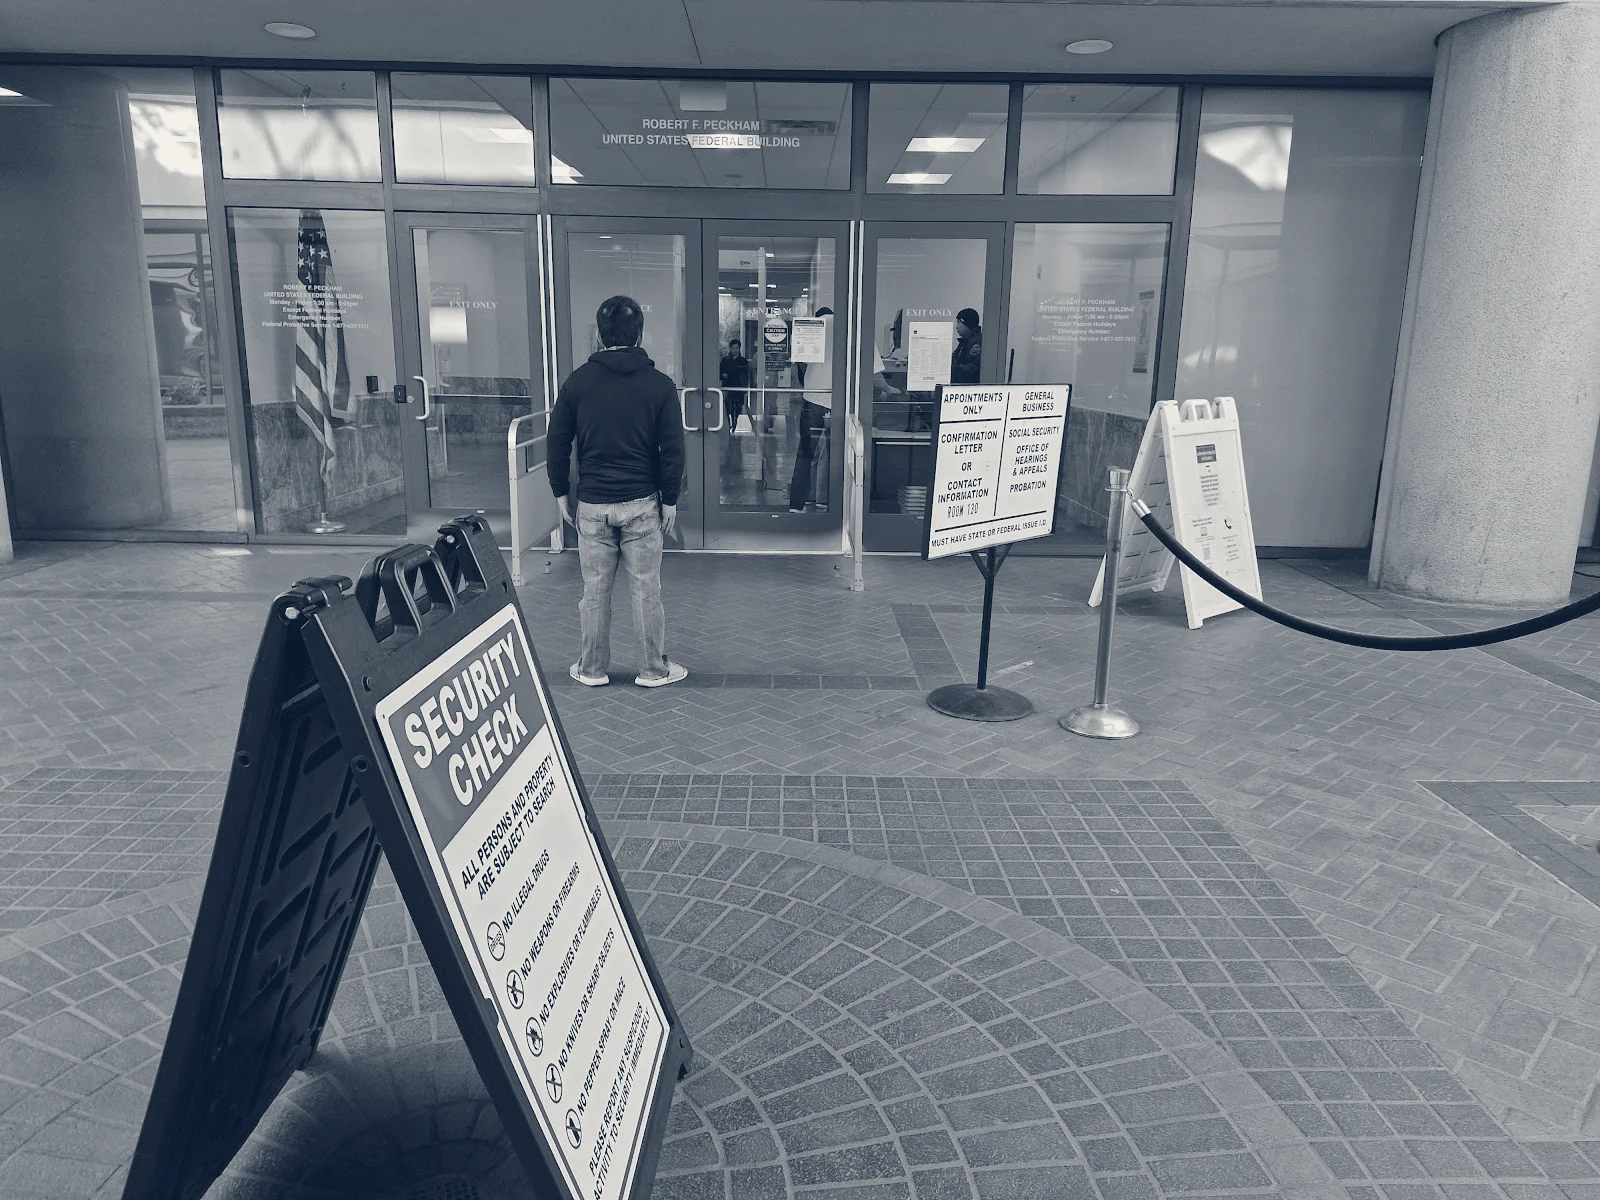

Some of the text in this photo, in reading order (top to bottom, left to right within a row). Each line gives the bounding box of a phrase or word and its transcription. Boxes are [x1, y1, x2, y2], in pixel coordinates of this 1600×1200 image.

[642, 119, 760, 131] ROBERT F. PECKHAM
[602, 134, 800, 148] UNITED STATES FEDERAL BUILDING
[450, 300, 498, 310] EXIT ONLY
[943, 392, 1003, 404] APPOINTMENTS
[1024, 391, 1054, 401] GENERAL
[962, 405, 983, 415] ONLY
[1022, 402, 1054, 412] BUSINESS
[941, 430, 998, 444] CONFIRMATION
[1008, 426, 1060, 438] SOCIAL SECURITY
[954, 444, 983, 454] LETTER
[1016, 442, 1050, 454] OFFICE OF
[961, 461, 972, 472] OR
[1014, 454, 1048, 466] HEARINGS
[1012, 464, 1048, 476] & APPEALS
[947, 478, 982, 490] CONTACT
[1009, 480, 1046, 493] PROBATION
[938, 488, 989, 504] INFORMATION
[947, 502, 979, 518] ROOM 130
[931, 536, 949, 548] MUST
[950, 534, 966, 544] HAVE
[968, 530, 986, 541] STATE
[987, 528, 996, 537] OR
[996, 524, 1021, 536] FEDERAL
[1022, 520, 1038, 530] ISSUE
[404, 632, 521, 769] SECURITY
[448, 692, 529, 806] CHECK
[461, 752, 554, 890] ALL PERSONS AND PROPERTY
[477, 776, 556, 900] ARE SUBJECT TO SEARCH
[502, 848, 550, 933] NO ILLEGAL DRUGS
[520, 862, 580, 981] NO WEAPONS OR FIREARMS
[538, 884, 602, 1027] NO EXPLOSIVES OR FLAMMABLES
[558, 928, 615, 1072] NO KNIVES OR SHARP OBJECTS
[577, 976, 626, 1116] NO PEPPER SPRAY OR MACE
[588, 1001, 644, 1177] PLEASE REPORT ANY SUSPICIOUS
[594, 1006, 652, 1200] ACTIVITY TO SECURITY IMMEDIATELY
